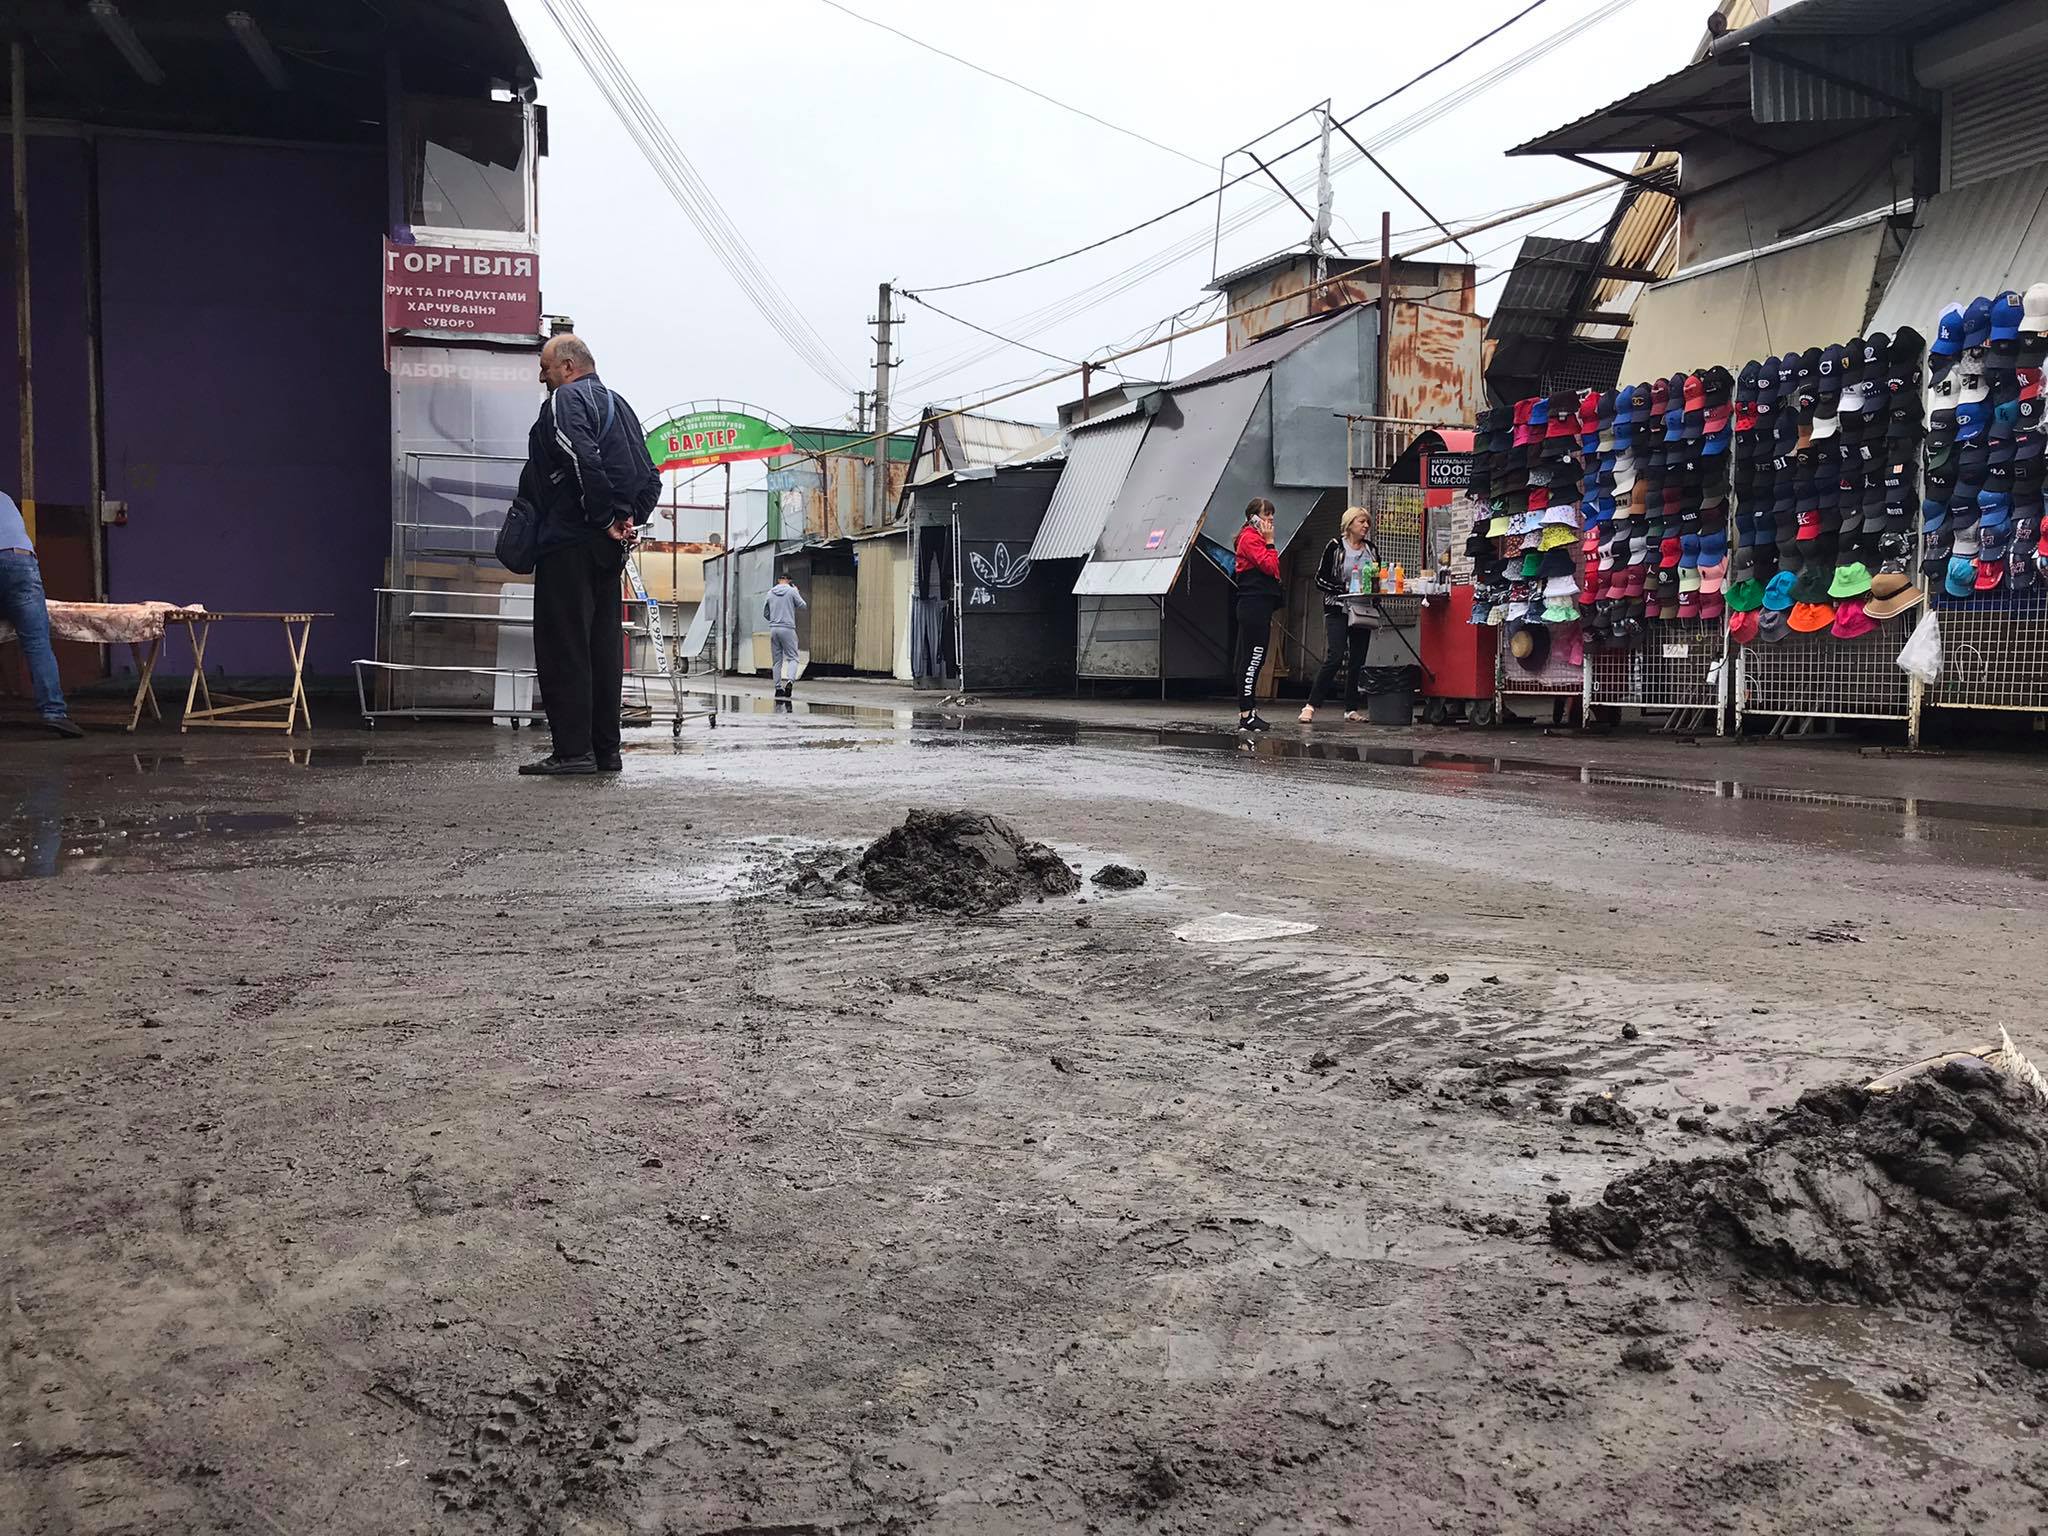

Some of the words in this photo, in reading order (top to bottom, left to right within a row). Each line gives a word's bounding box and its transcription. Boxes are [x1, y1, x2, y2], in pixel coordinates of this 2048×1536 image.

[387, 251, 532, 277] ТОРГІВЛЯ
[416, 287, 434, 298] ТА
[437, 288, 527, 302] ПРОДУКТАМИ
[407, 301, 496, 315] ХАРЧУВАННЯ
[424, 317, 475, 329] СУВОРО
[391, 362, 532, 382] АБОРОНЕНО
[668, 428, 737, 454] БАРТЕР
[1431, 464, 1473, 476] КОФЕ
[652, 626, 665, 655] 9977
